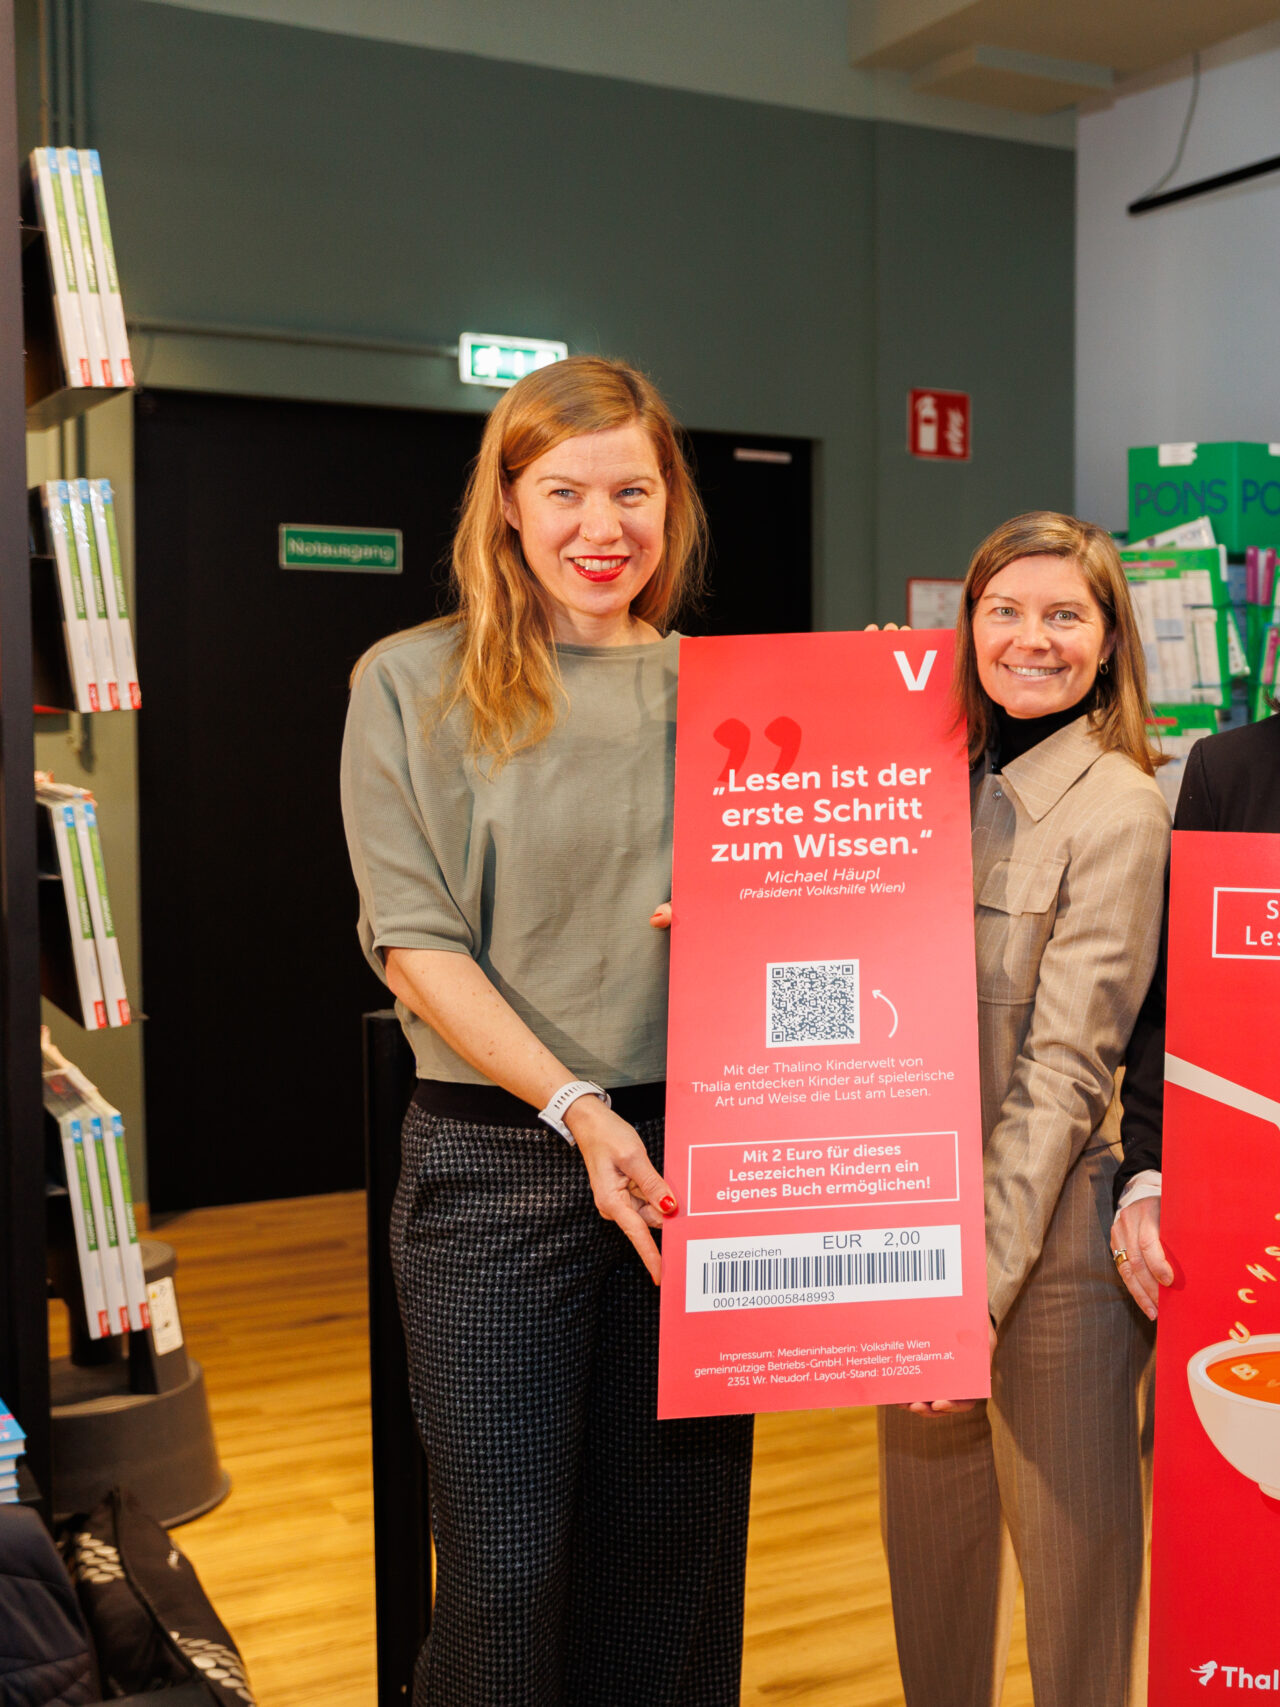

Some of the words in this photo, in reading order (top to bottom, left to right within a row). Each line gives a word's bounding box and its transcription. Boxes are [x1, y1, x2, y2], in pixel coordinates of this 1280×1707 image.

[1134, 479, 1228, 517] PONS
[287, 537, 394, 561] Notausgang
[893, 650, 937, 691] V
[832, 765, 868, 788] ist
[878, 763, 931, 786] der
[722, 803, 803, 826] erste
[814, 797, 922, 823] Schritt
[712, 842, 782, 862] zum
[765, 869, 828, 884] Michael
[833, 867, 880, 882] Häupl
[740, 887, 802, 900] (Präsident
[807, 884, 866, 896] Volkshilfe
[870, 882, 905, 893] Wien)
[724, 1065, 744, 1076] Mit
[748, 1064, 769, 1075] der
[773, 1061, 822, 1072] Thalino
[827, 1057, 895, 1070] Kinderwelt
[899, 1058, 923, 1067] von
[692, 1081, 731, 1093] Thalia
[735, 1077, 804, 1090] entdecken
[809, 1075, 850, 1086] Kinder
[854, 1073, 874, 1084] auf
[878, 1070, 954, 1085] spielerische
[715, 1096, 734, 1107] Art
[738, 1094, 764, 1106] und
[768, 1092, 807, 1104] Weise
[811, 1091, 831, 1102] die
[835, 1089, 861, 1101] Lust
[865, 1090, 886, 1099] am
[890, 1087, 930, 1098] Lesen.
[743, 1150, 768, 1163] Mit
[772, 1149, 781, 1161] 2
[787, 1148, 823, 1160] Euro
[827, 1146, 849, 1158] für
[853, 1144, 901, 1157] dieses
[729, 1165, 825, 1181] Lesezeichen
[830, 1162, 891, 1176] Kindern
[895, 1160, 919, 1172] ein
[716, 1187, 777, 1202] eigenes
[782, 1182, 821, 1196] Buch
[826, 1176, 930, 1195] ermöglichen!
[823, 1234, 862, 1249] EUR
[884, 1231, 920, 1247] 2,00
[711, 1248, 781, 1260] Lesezeichen
[713, 1291, 834, 1308] 00012400005848993
[720, 1351, 774, 1362] Impressum:
[778, 1344, 857, 1357] Medieninhaberin:
[860, 1341, 904, 1352] Volkshilfe
[907, 1340, 930, 1349] Wien
[694, 1363, 765, 1378] gemeinnützige
[768, 1357, 843, 1371] Betriebs-GmbH.
[846, 1355, 893, 1366] Hersteller:
[896, 1352, 955, 1365] flyeralarm.at,
[728, 1376, 750, 1386] 2351
[752, 1376, 767, 1384] Wr.
[770, 1372, 811, 1383] Neudorf.
[814, 1368, 879, 1382] Layout-Stand:
[882, 1365, 922, 1376] 10/2025.
